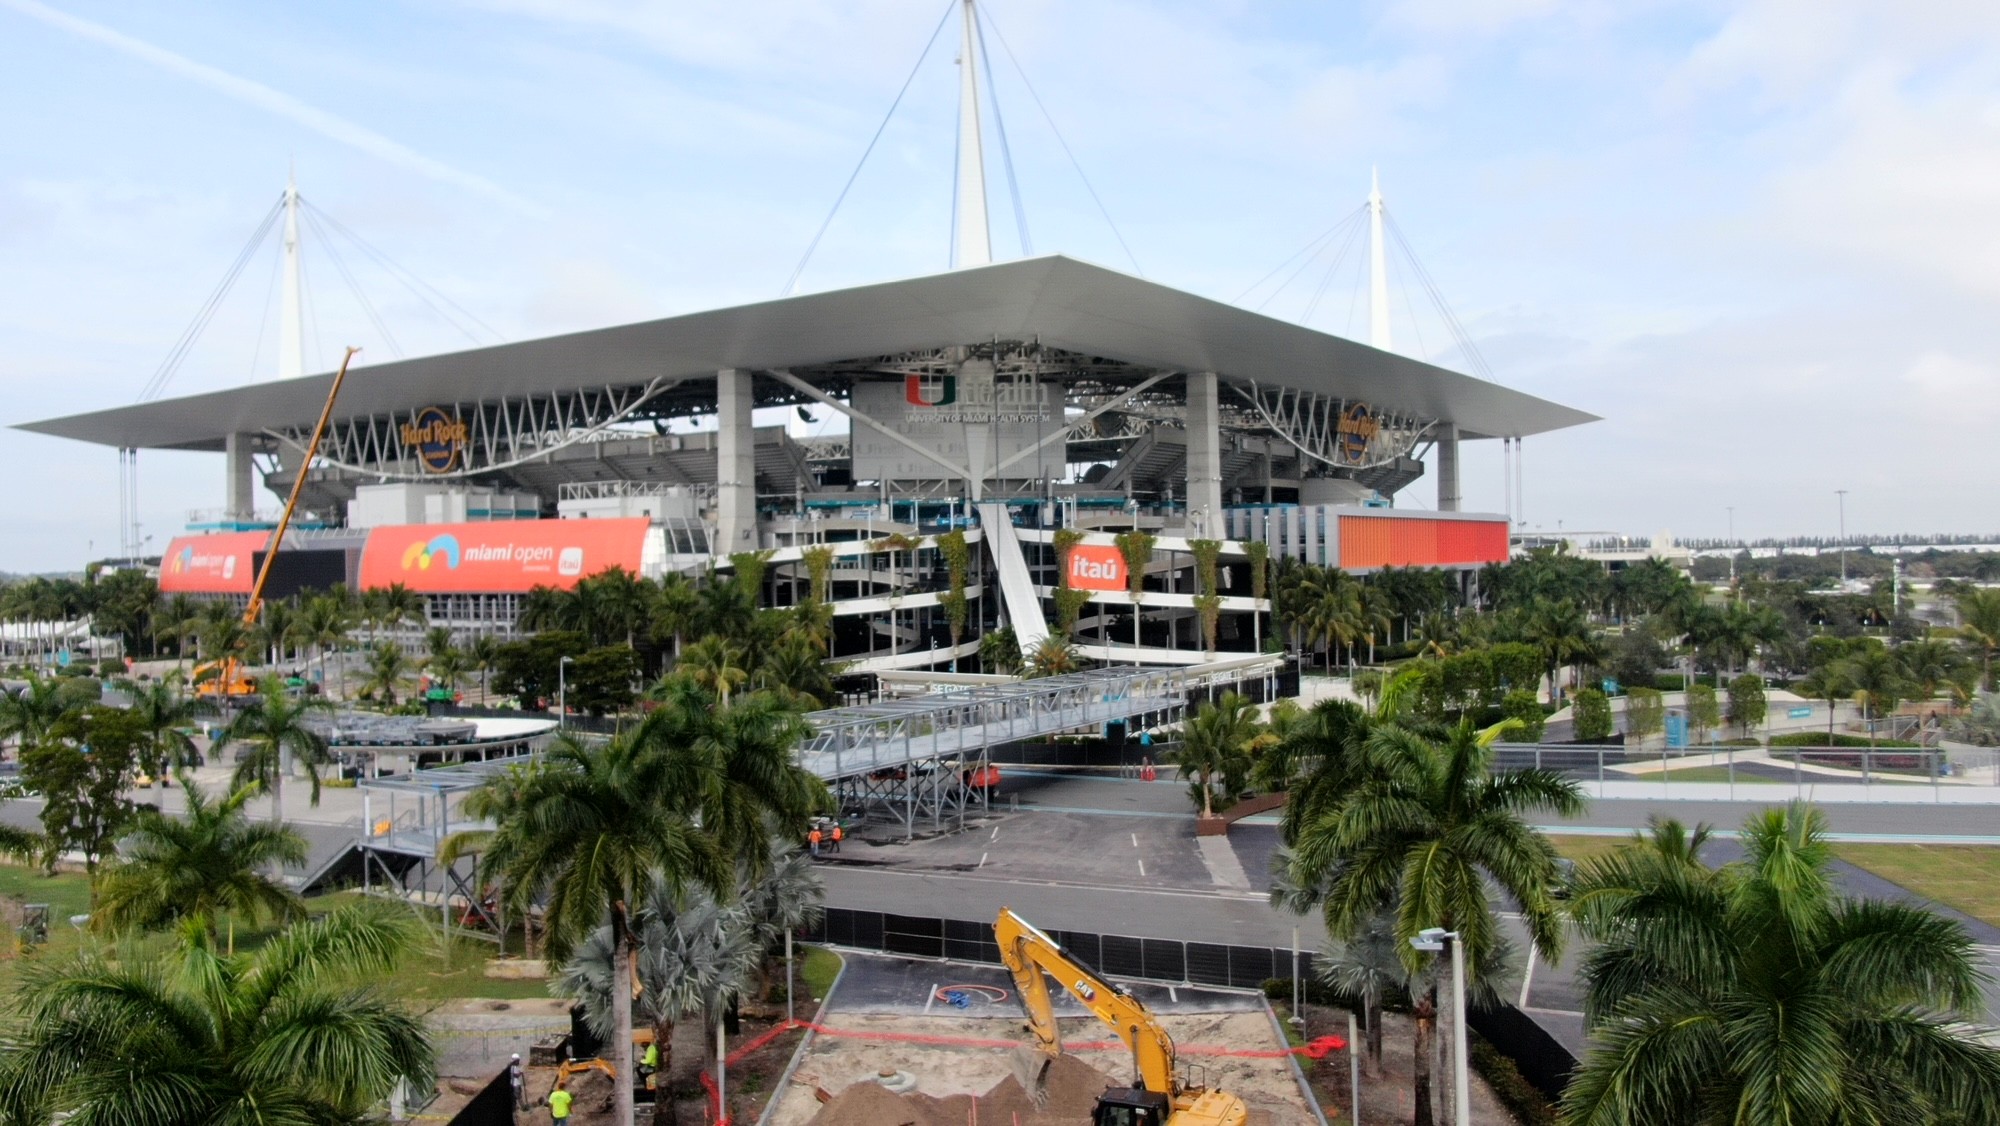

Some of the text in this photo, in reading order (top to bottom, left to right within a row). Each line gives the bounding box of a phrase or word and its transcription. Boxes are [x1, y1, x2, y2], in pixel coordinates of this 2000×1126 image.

[905, 414, 1050, 424] UNIVERSITY OF MIAMI HEALTH SYSTEM
[400, 419, 467, 447] Hard Rock
[465, 543, 553, 565] miami open
[1072, 554, 1117, 580] itaú
[931, 683, 943, 694] SE
[1075, 980, 1094, 998] CAT
